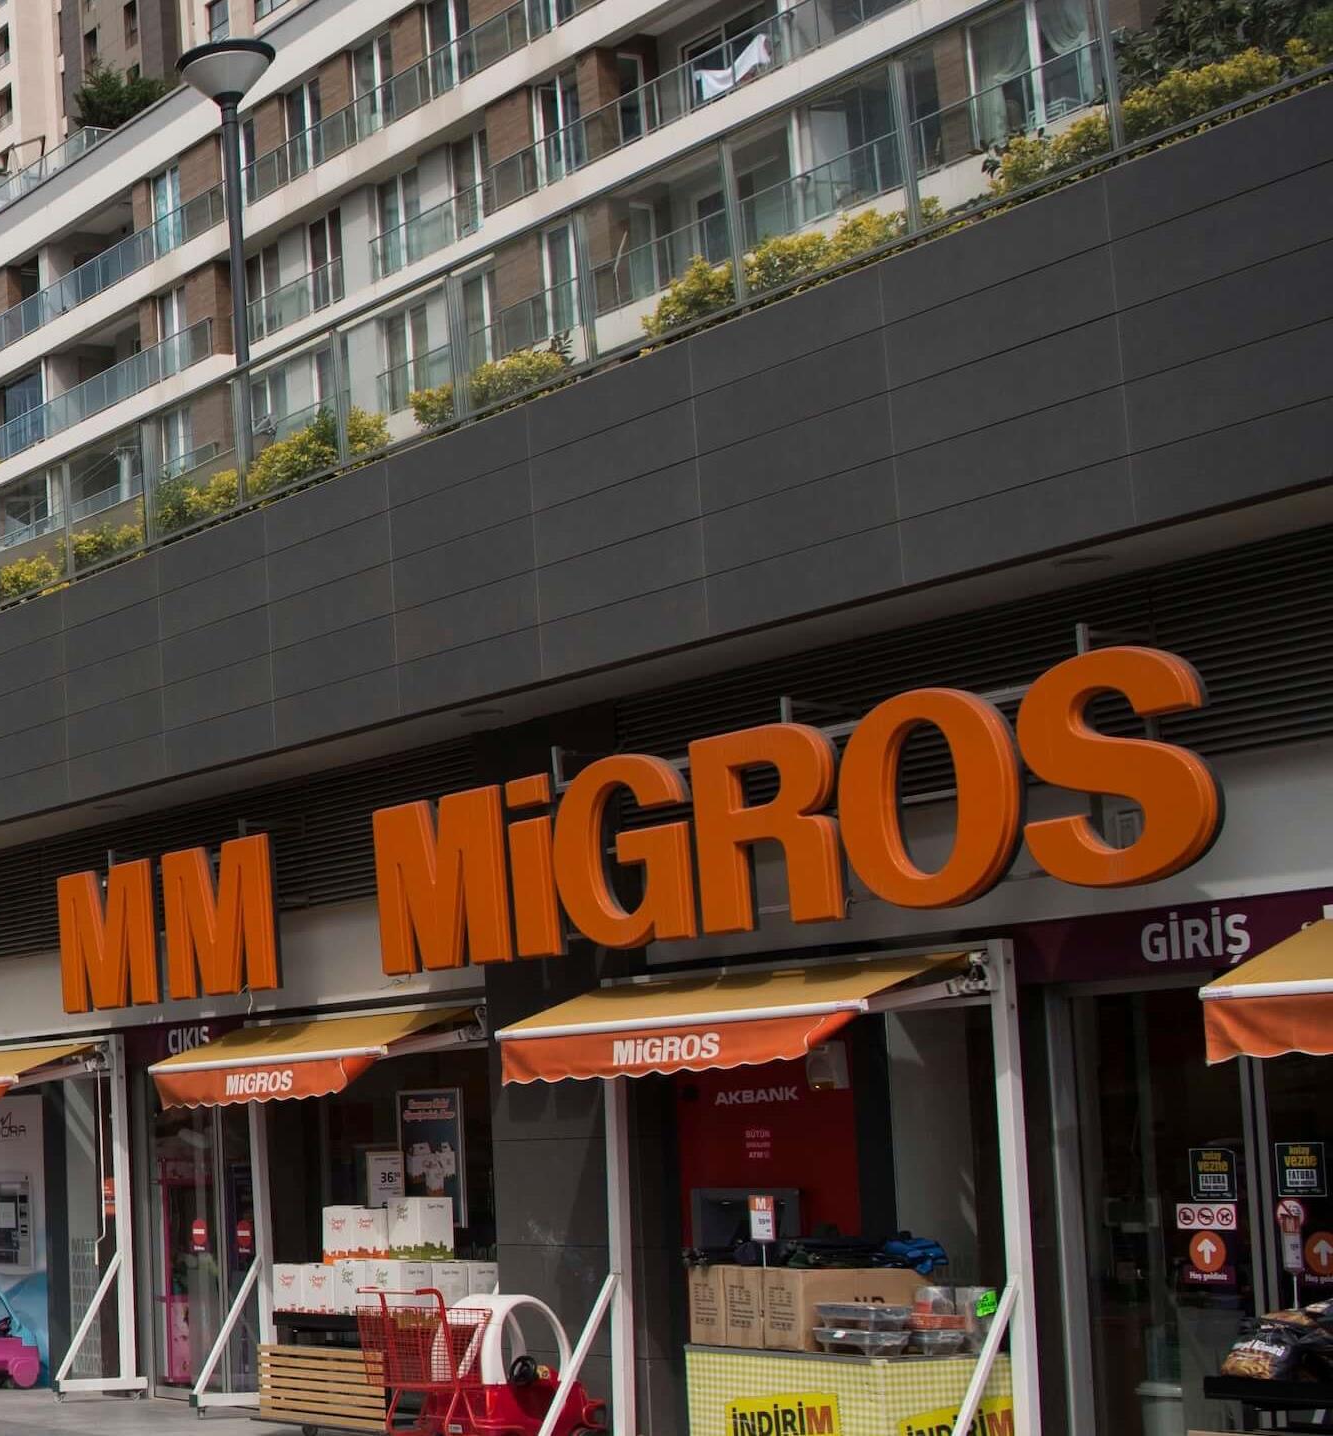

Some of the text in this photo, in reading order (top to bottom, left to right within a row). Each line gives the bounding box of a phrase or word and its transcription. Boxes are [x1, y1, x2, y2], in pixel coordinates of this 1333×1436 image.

[57, 832, 283, 1015] MM
[1141, 906, 1251, 964] GİRİŞ
[612, 1032, 720, 1066] MiGROS
[226, 1069, 294, 1096] MiGROS
[714, 1086, 799, 1106] AKBANK
[1197, 1161, 1229, 1172] vezne
[1284, 1156, 1318, 1168] vezne
[1288, 1171, 1315, 1180] FATURA
[731, 1401, 833, 1436] İNDİRİM
